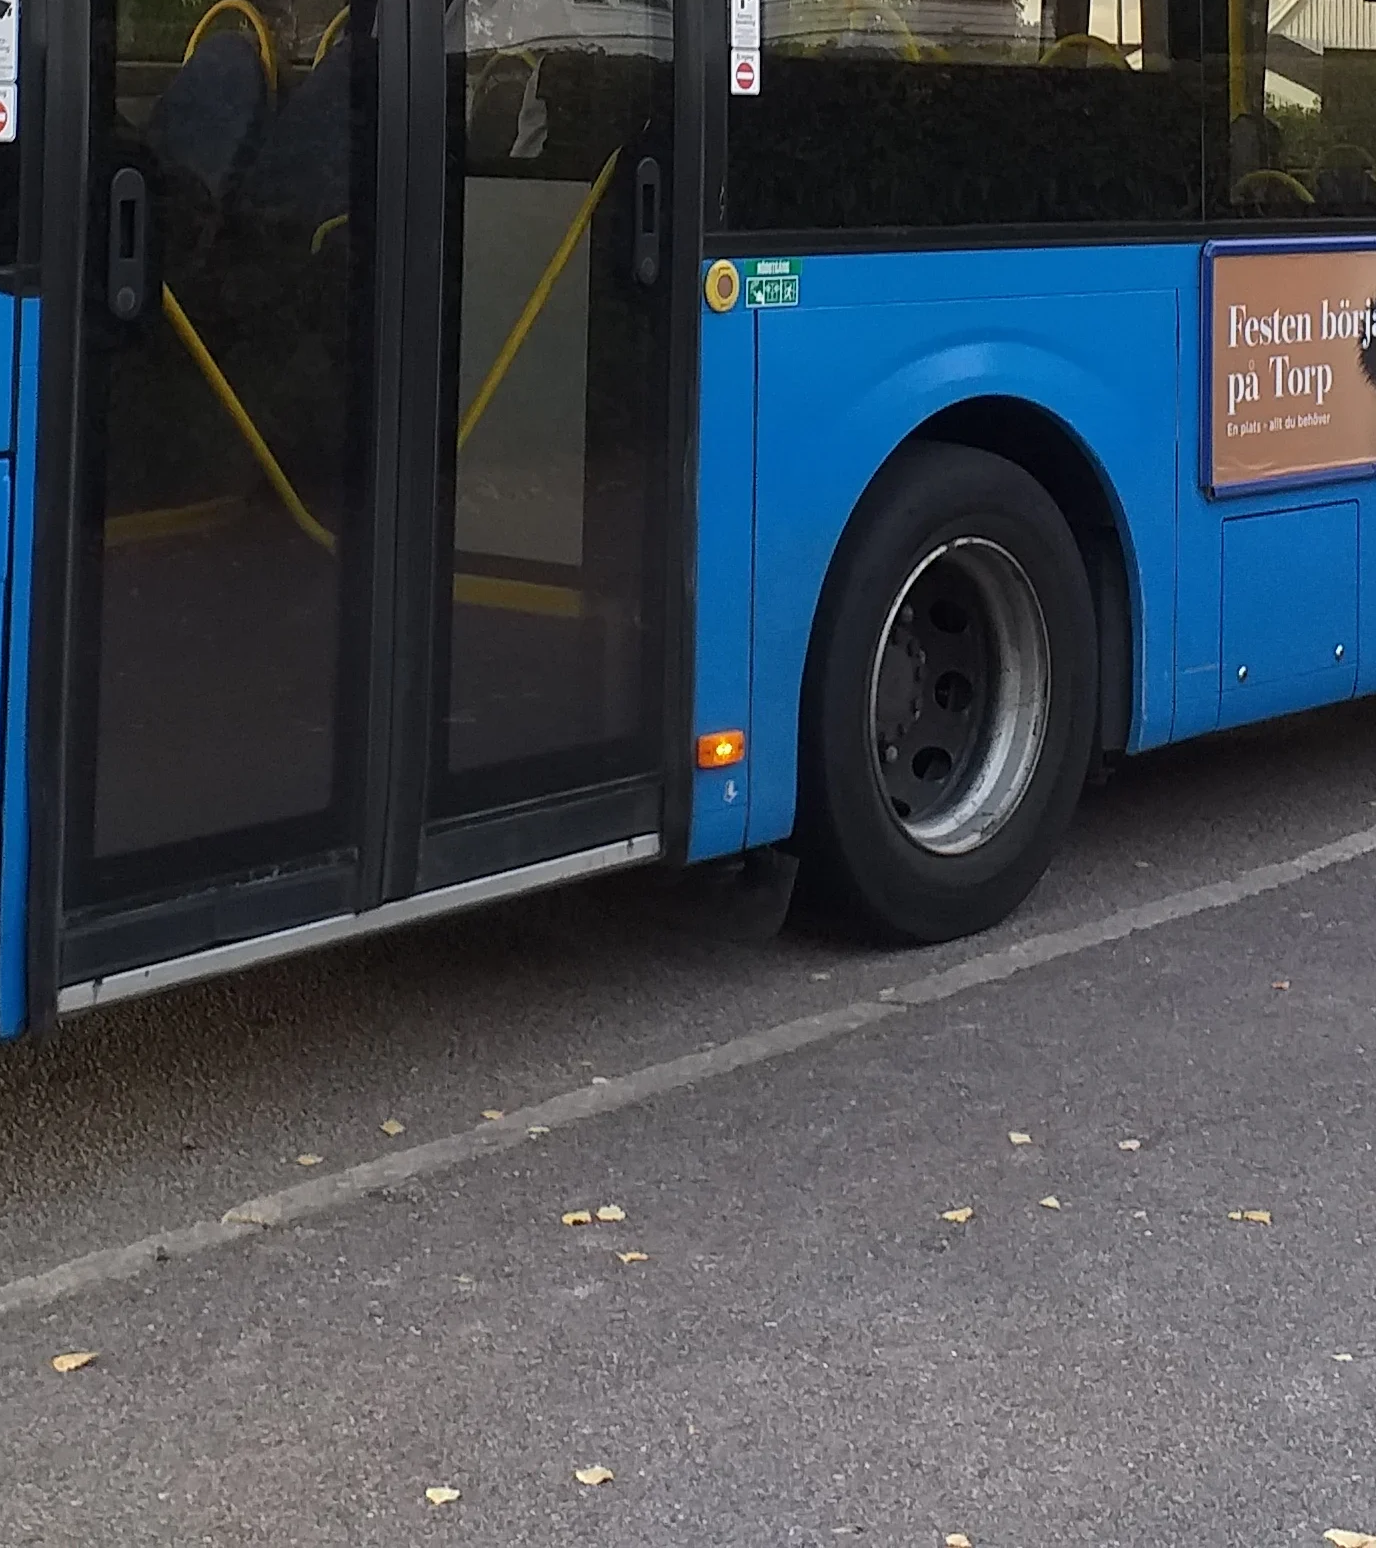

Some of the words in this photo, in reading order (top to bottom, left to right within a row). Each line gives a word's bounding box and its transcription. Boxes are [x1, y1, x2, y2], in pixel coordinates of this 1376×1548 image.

[1228, 304, 1313, 348] Festen
[1227, 359, 1260, 415] på
[1268, 355, 1333, 405] Torp
[1227, 422, 1239, 437] En
[1284, 415, 1296, 429] du
